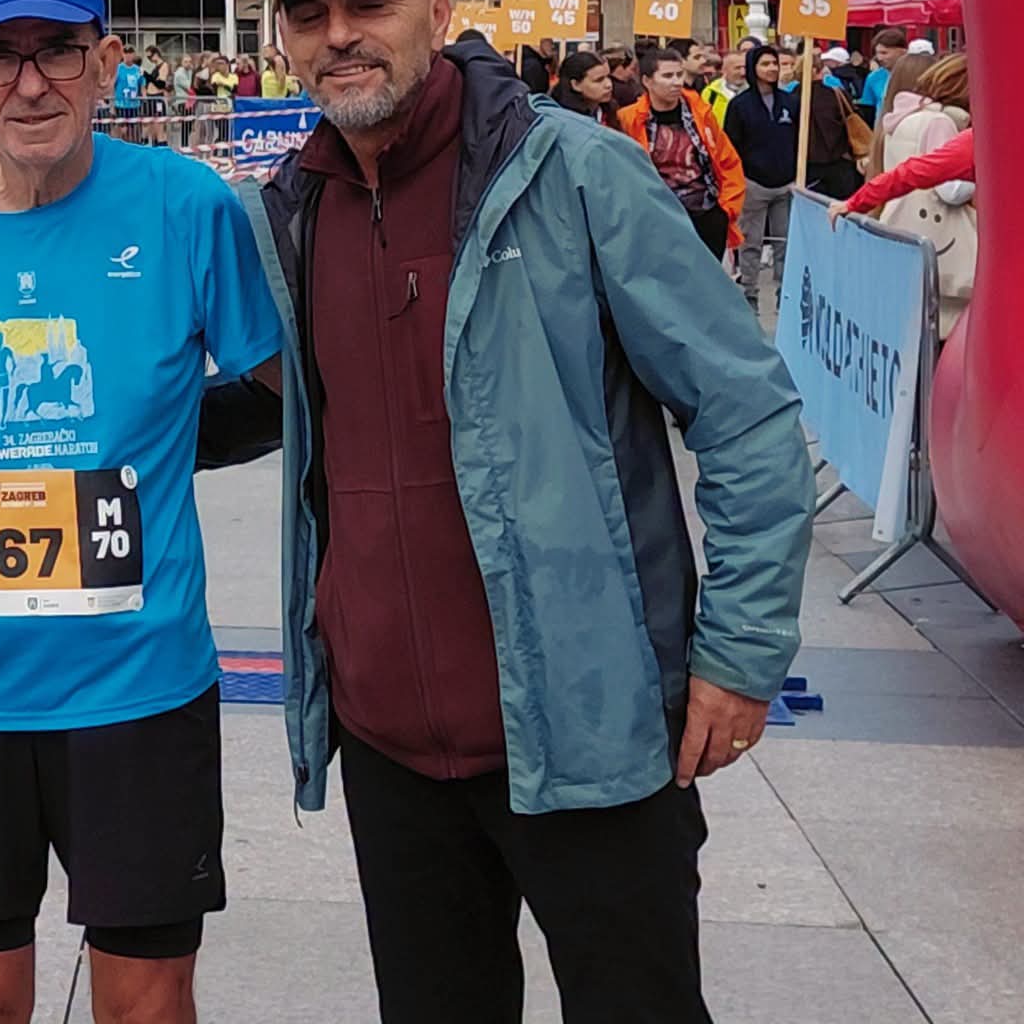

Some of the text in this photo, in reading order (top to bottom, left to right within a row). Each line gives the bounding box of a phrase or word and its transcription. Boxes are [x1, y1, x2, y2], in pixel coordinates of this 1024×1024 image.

[509, 9, 536, 21] W/M
[551, 10, 576, 26] 45
[648, 2, 679, 21] 40
[1, 490, 47, 502] ZAGREB
[96, 497, 123, 527] M
[90, 529, 131, 559] 70
